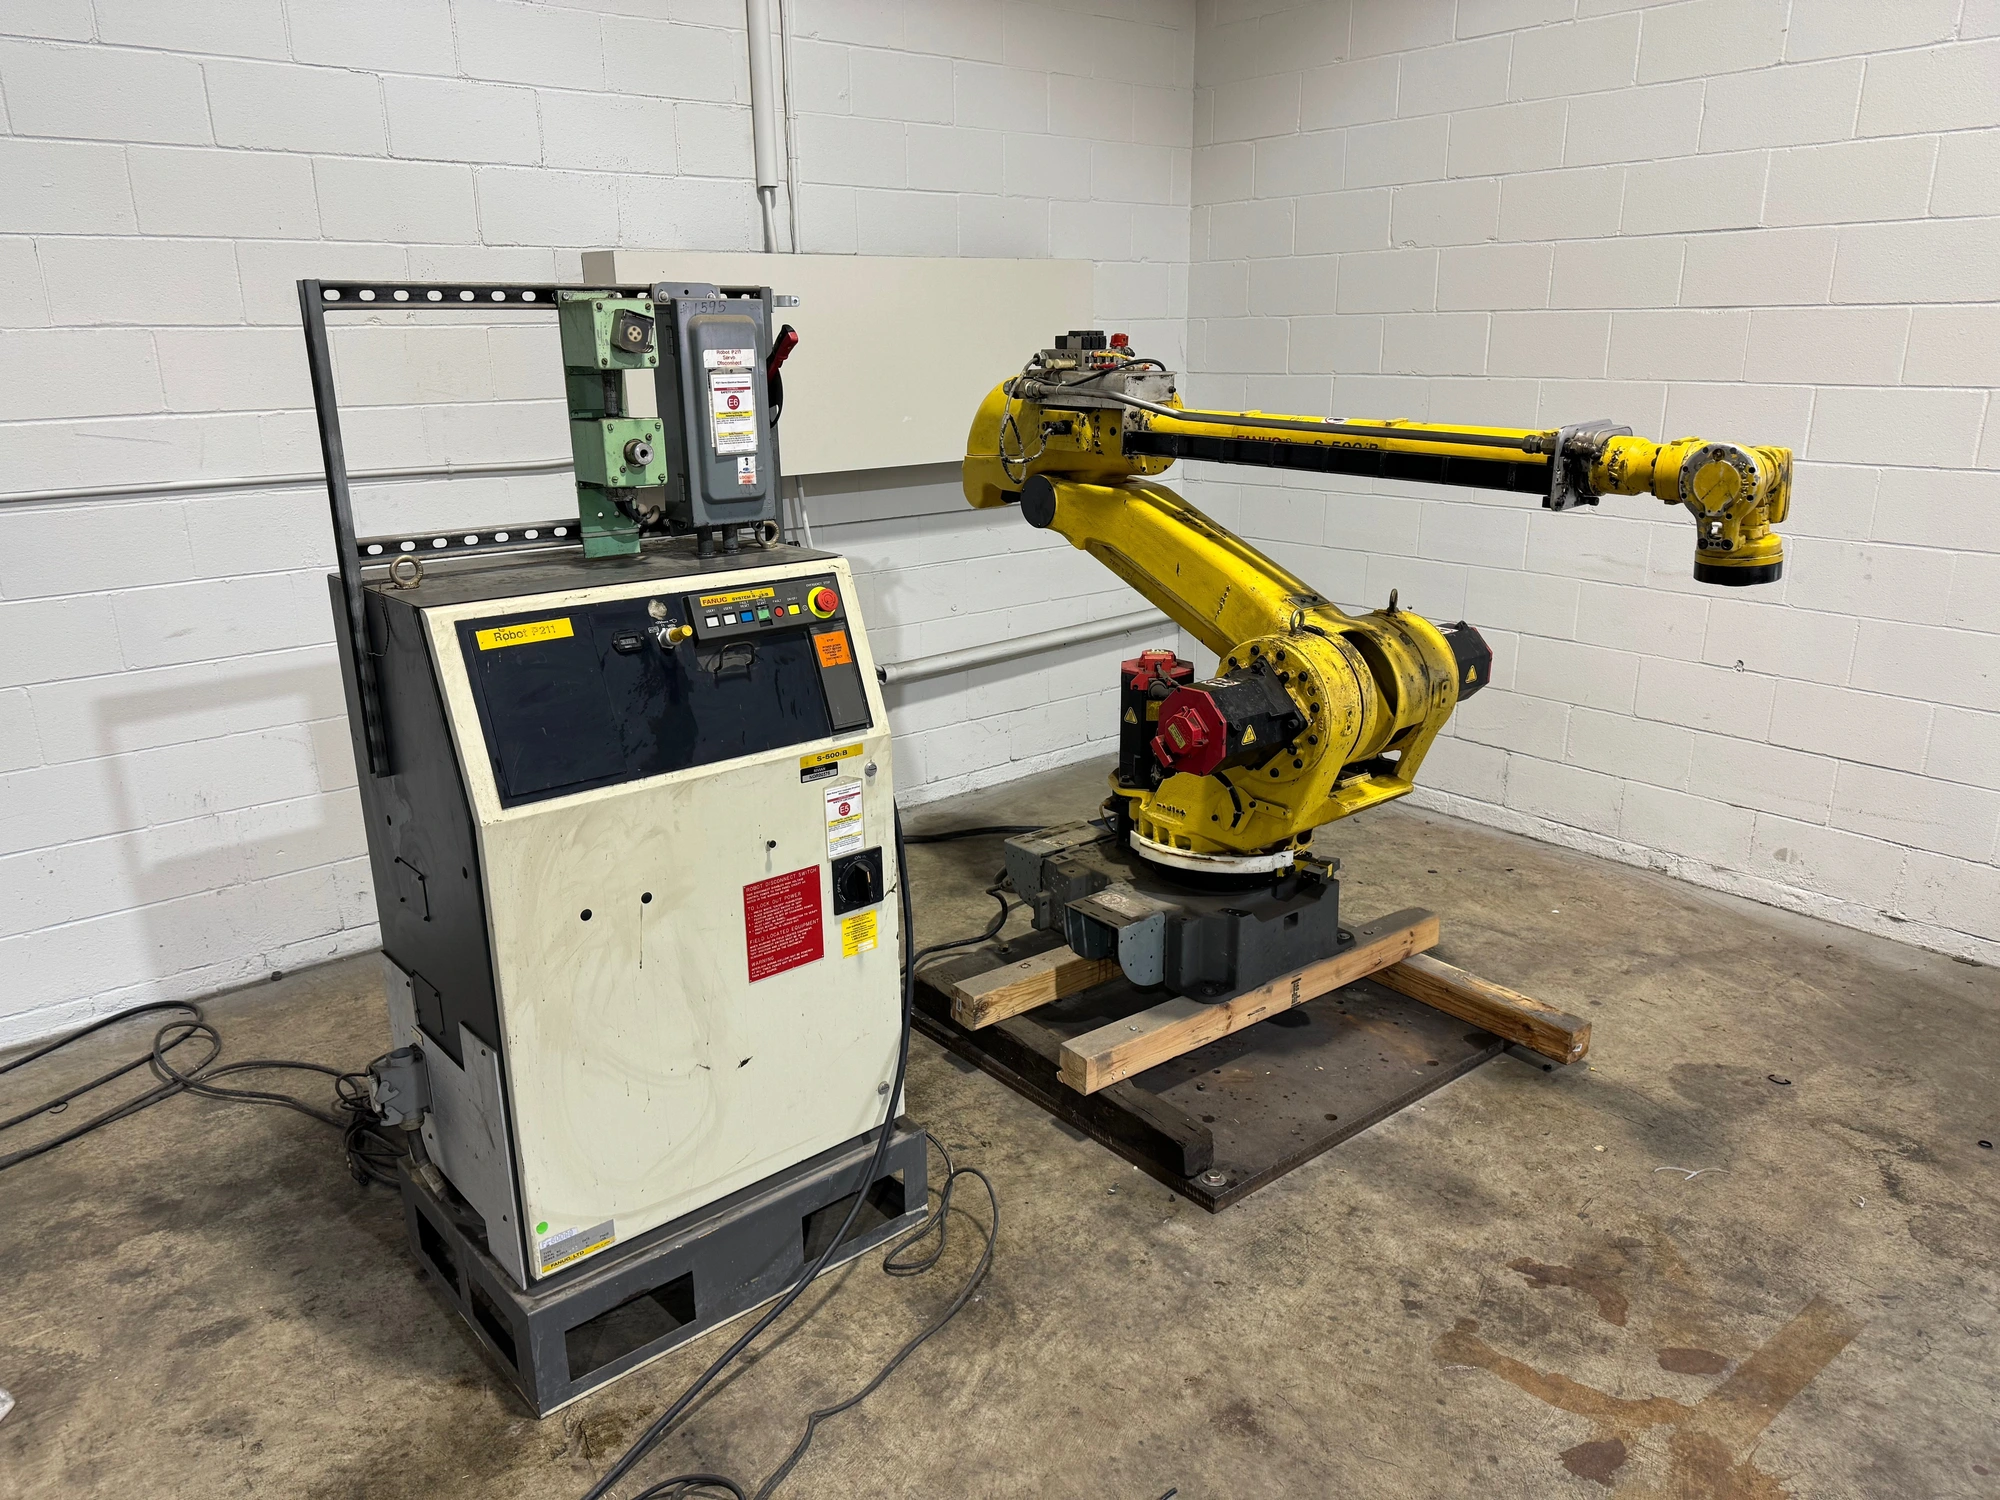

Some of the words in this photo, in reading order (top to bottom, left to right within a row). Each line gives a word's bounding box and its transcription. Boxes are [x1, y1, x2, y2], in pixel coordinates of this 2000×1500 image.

[728, 398, 739, 407] E6
[702, 596, 728, 605] FANUC
[732, 593, 751, 601] SYSTEM
[493, 628, 528, 642] Robot
[840, 805, 849, 814] E5
[745, 883, 763, 892] ROBOT
[765, 874, 795, 886] DISCONNECT
[798, 867, 816, 877] SWITCH
[784, 892, 801, 900] POWER
[749, 936, 764, 945] FIELD
[766, 928, 789, 939] LOCATED
[791, 918, 819, 931] EQUIPMENT
[751, 955, 774, 967] WARNING
[550, 1256, 571, 1268] FANUC
[572, 1250, 585, 1258] LTD
